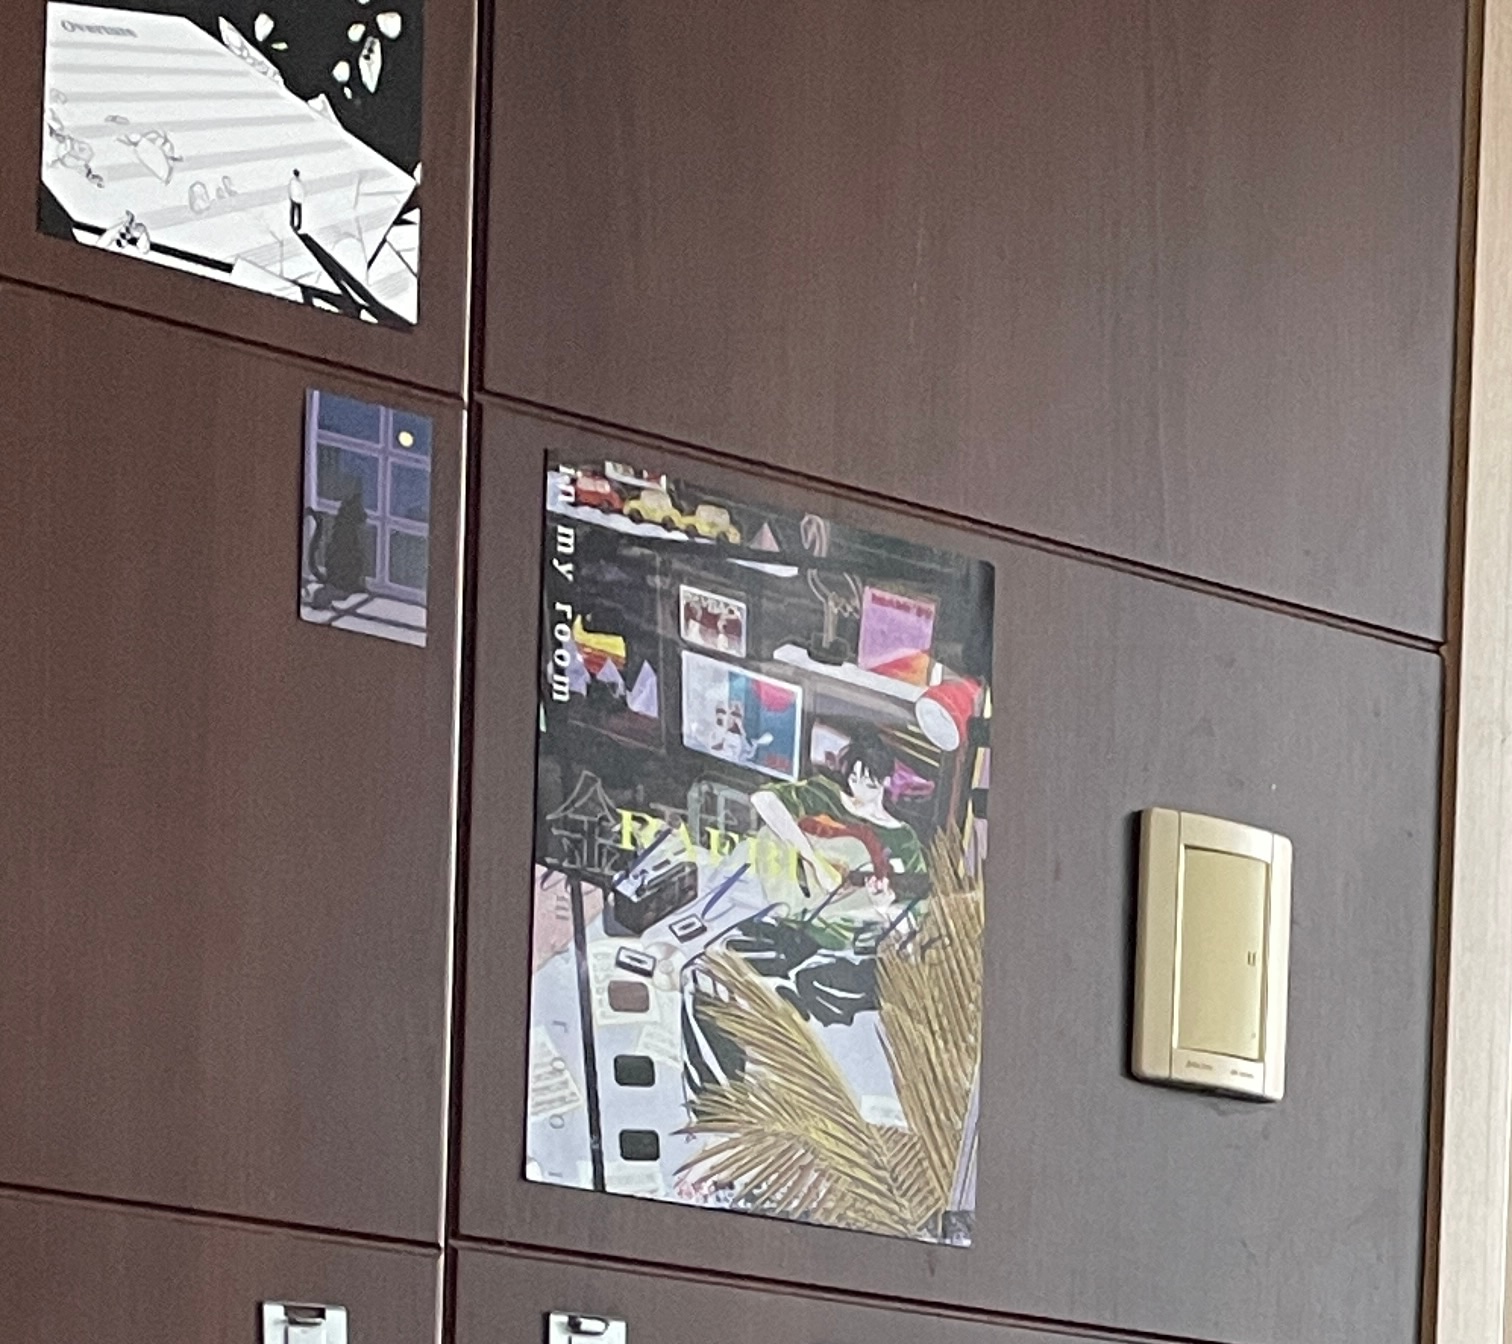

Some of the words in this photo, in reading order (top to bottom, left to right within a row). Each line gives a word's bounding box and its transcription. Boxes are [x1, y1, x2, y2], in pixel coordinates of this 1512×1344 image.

[558, 465, 581, 502] in
[553, 526, 575, 583] my
[553, 602, 573, 702] room
